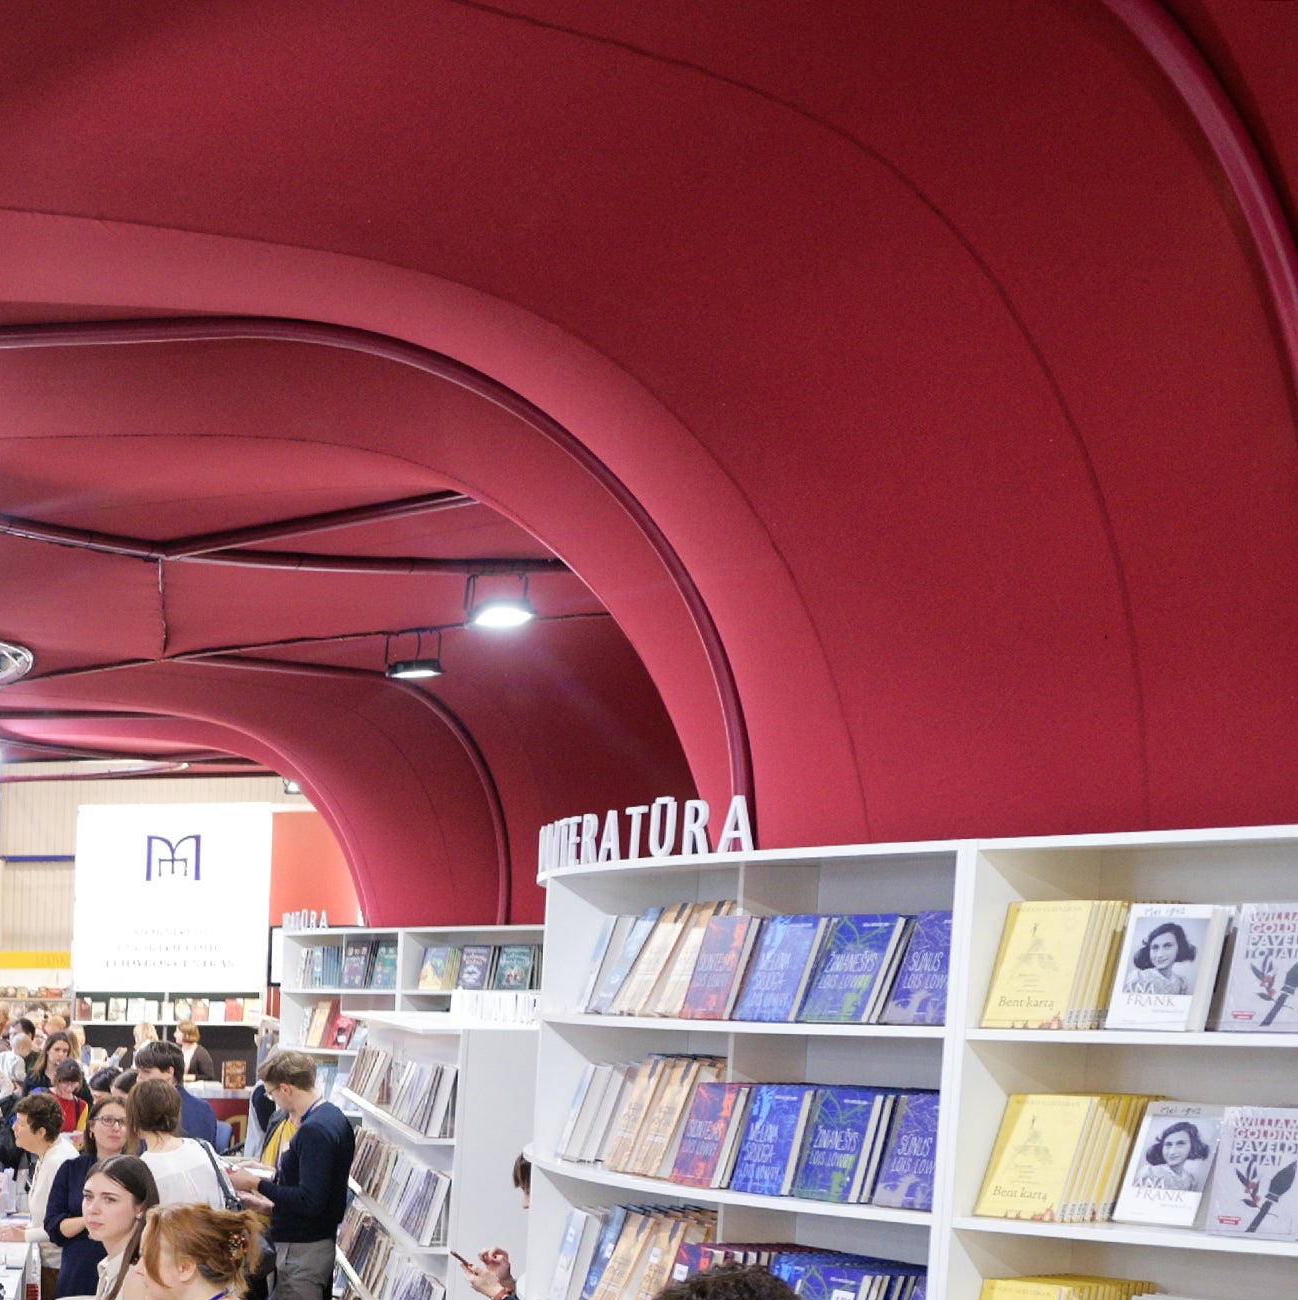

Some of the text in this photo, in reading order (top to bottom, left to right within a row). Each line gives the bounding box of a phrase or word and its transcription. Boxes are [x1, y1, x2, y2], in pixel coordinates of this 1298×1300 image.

[1125, 982, 1156, 995] ANA
[999, 996, 1023, 1008] Bent
[1127, 993, 1175, 1007] FRANK
[1133, 1177, 1165, 1189] ANA
[993, 1185, 1017, 1198] Bent
[1136, 1189, 1184, 1203] FRANK
